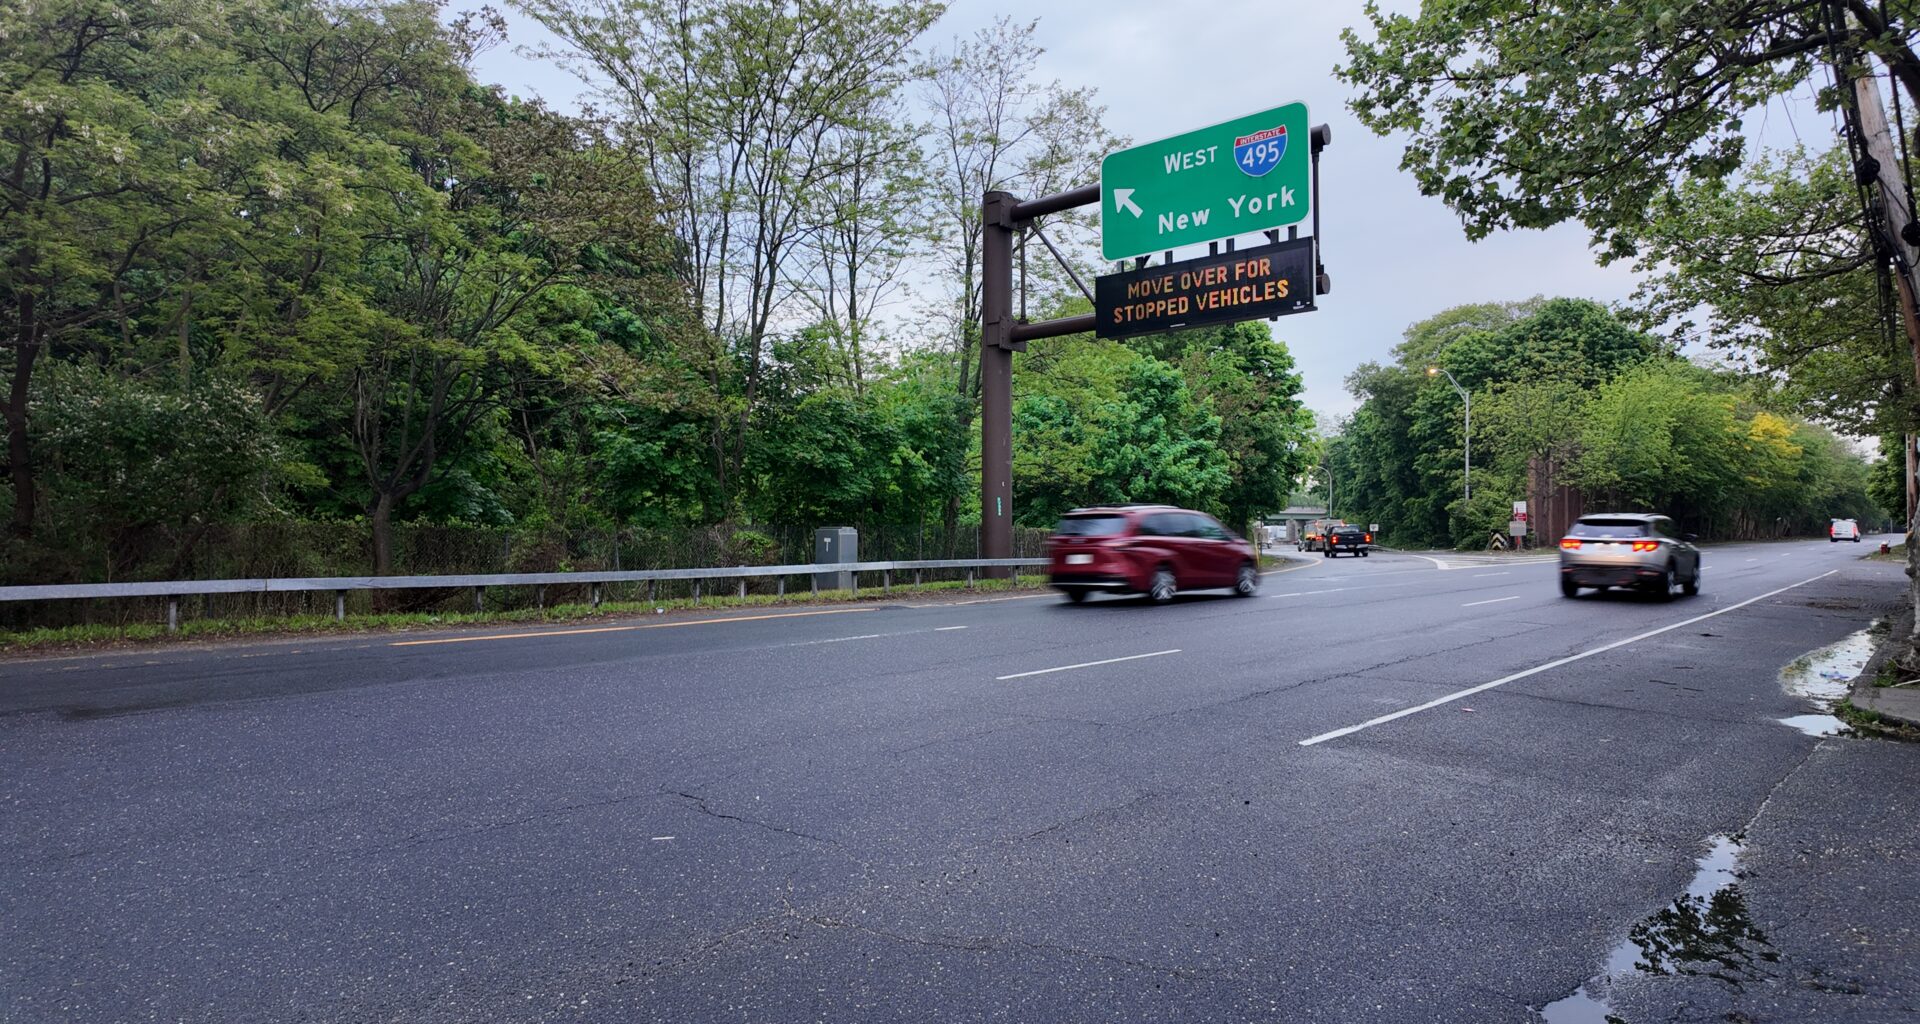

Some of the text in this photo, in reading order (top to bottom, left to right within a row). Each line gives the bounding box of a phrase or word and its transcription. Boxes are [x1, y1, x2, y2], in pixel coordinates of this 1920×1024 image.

[1240, 129, 1280, 145] INTERSTATE
[1242, 140, 1280, 168] 495
[1164, 146, 1218, 174] WEST
[1158, 185, 1295, 235] New York
[1127, 258, 1271, 299] MOVE OVER FOR
[1113, 279, 1289, 324] STOPPED VEHICLES
